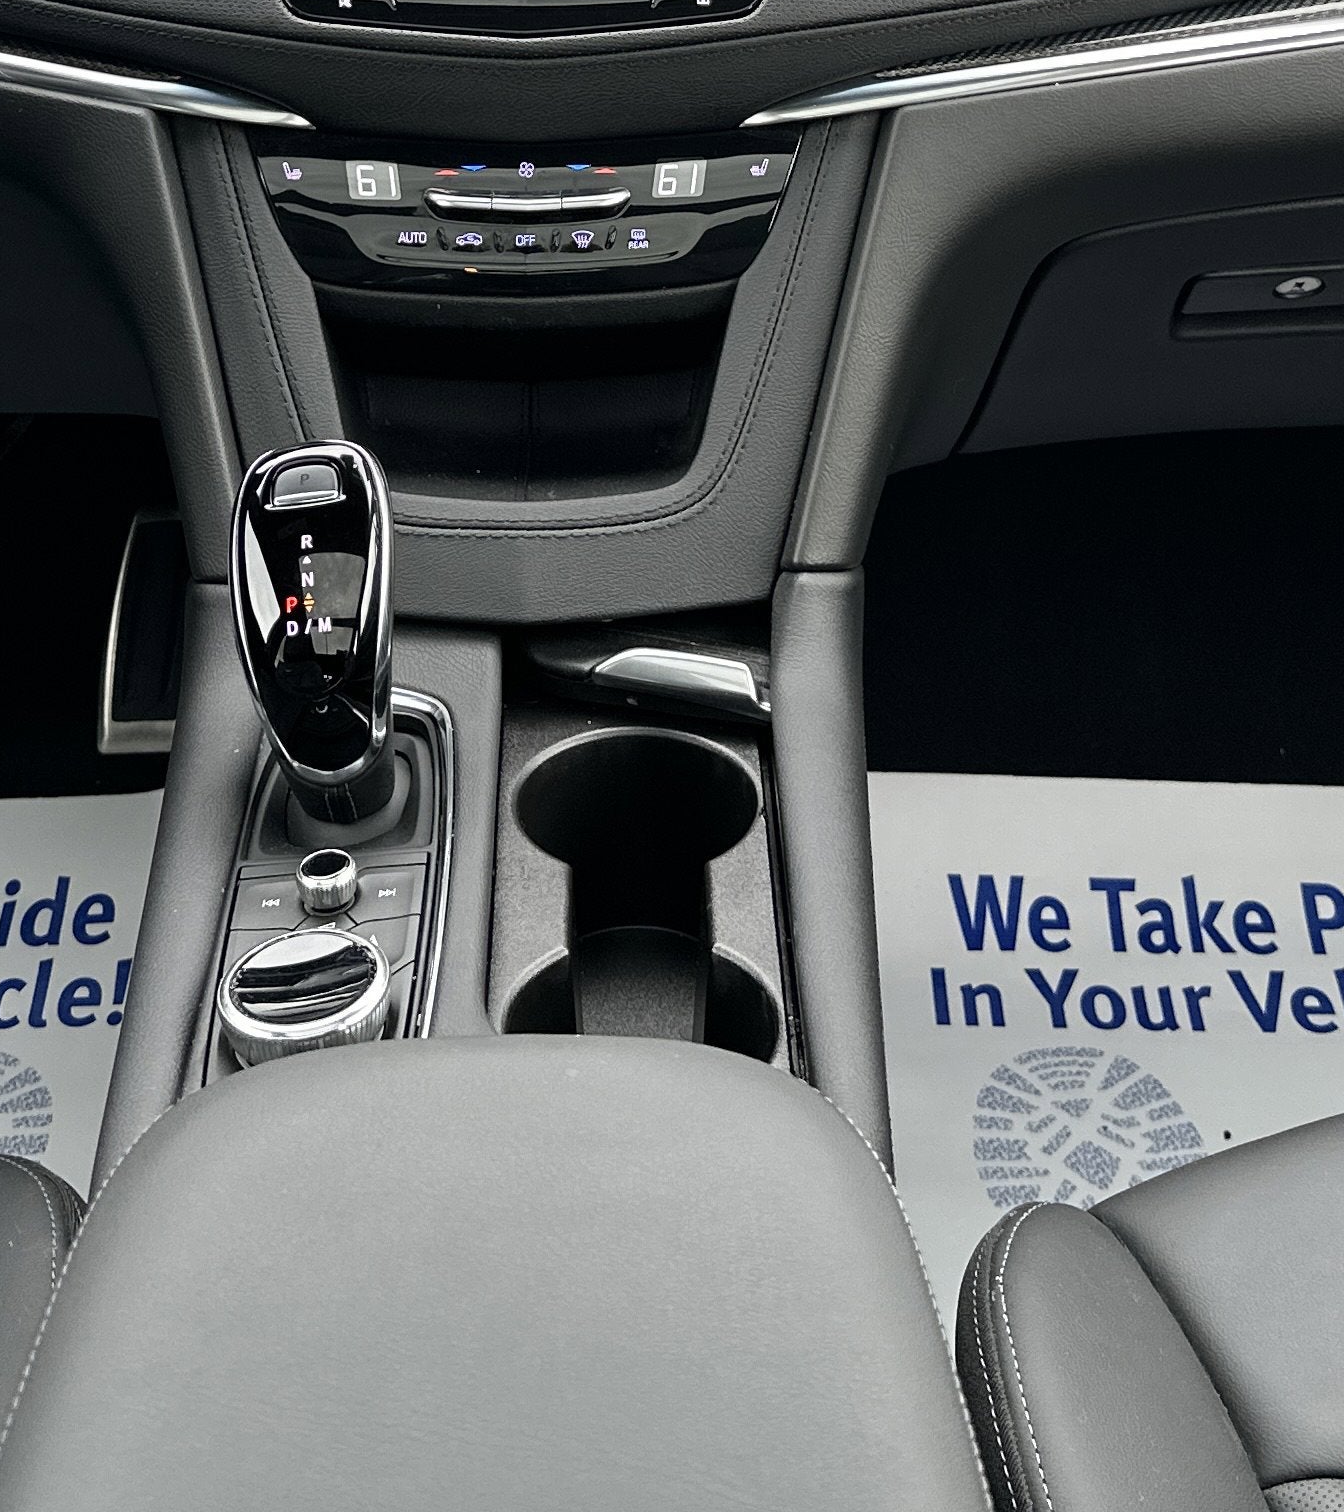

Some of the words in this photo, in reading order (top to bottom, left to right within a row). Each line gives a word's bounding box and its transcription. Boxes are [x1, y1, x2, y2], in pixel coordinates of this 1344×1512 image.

[356, 164, 396, 197] 61
[658, 163, 697, 196] 61
[398, 231, 427, 245] AUTO
[515, 233, 536, 246] OFF
[627, 240, 649, 249] REAR
[300, 474, 310, 485] P
[300, 534, 313, 549] R
[301, 572, 314, 587] N
[286, 596, 298, 613] P
[947, 873, 1071, 952] We
[1089, 876, 1278, 955] Take
[930, 967, 1007, 1027] In
[1024, 968, 1211, 1033] Your
